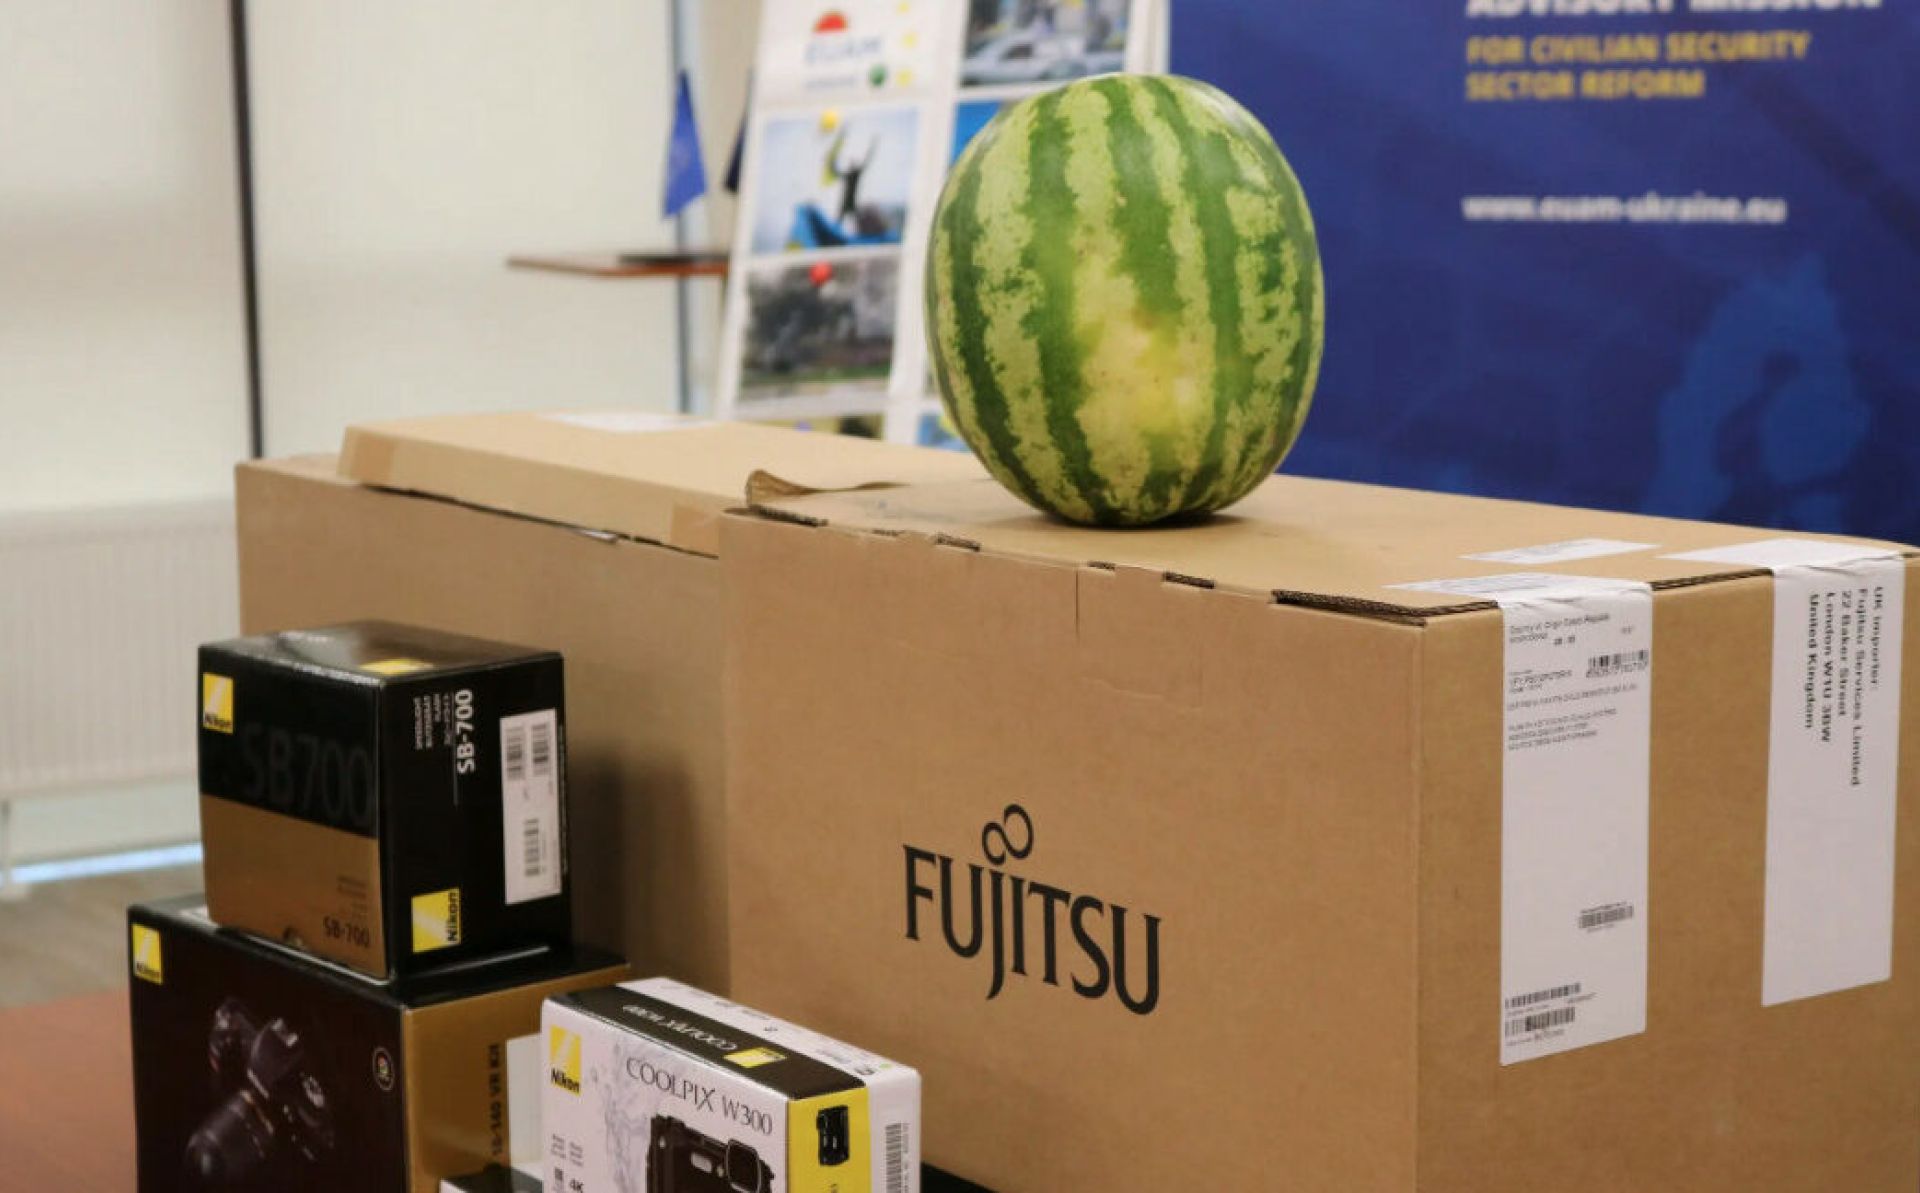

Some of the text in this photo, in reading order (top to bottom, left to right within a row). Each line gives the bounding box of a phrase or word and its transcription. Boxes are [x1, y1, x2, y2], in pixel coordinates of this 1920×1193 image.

[1467, 31, 1811, 64] FOR CIVILIAN SECURITY
[1466, 70, 1706, 100] SECTOR REFORM
[1824, 592, 1836, 656] London
[1874, 586, 1883, 610] UK
[1804, 594, 1820, 728] United Kingdom
[1823, 661, 1834, 699] W1U
[1838, 591, 1851, 716] 22 Baker Street
[1851, 588, 1868, 786] Fujitsu Services Limited
[455, 688, 476, 774] SB-700
[240, 721, 374, 827] SB700
[323, 915, 370, 948] SB-700
[448, 892, 458, 942] Nikon
[902, 842, 1162, 1016] FUJITSU
[550, 1068, 580, 1094] Nikon
[626, 1057, 773, 1135] COOLPIX W300
